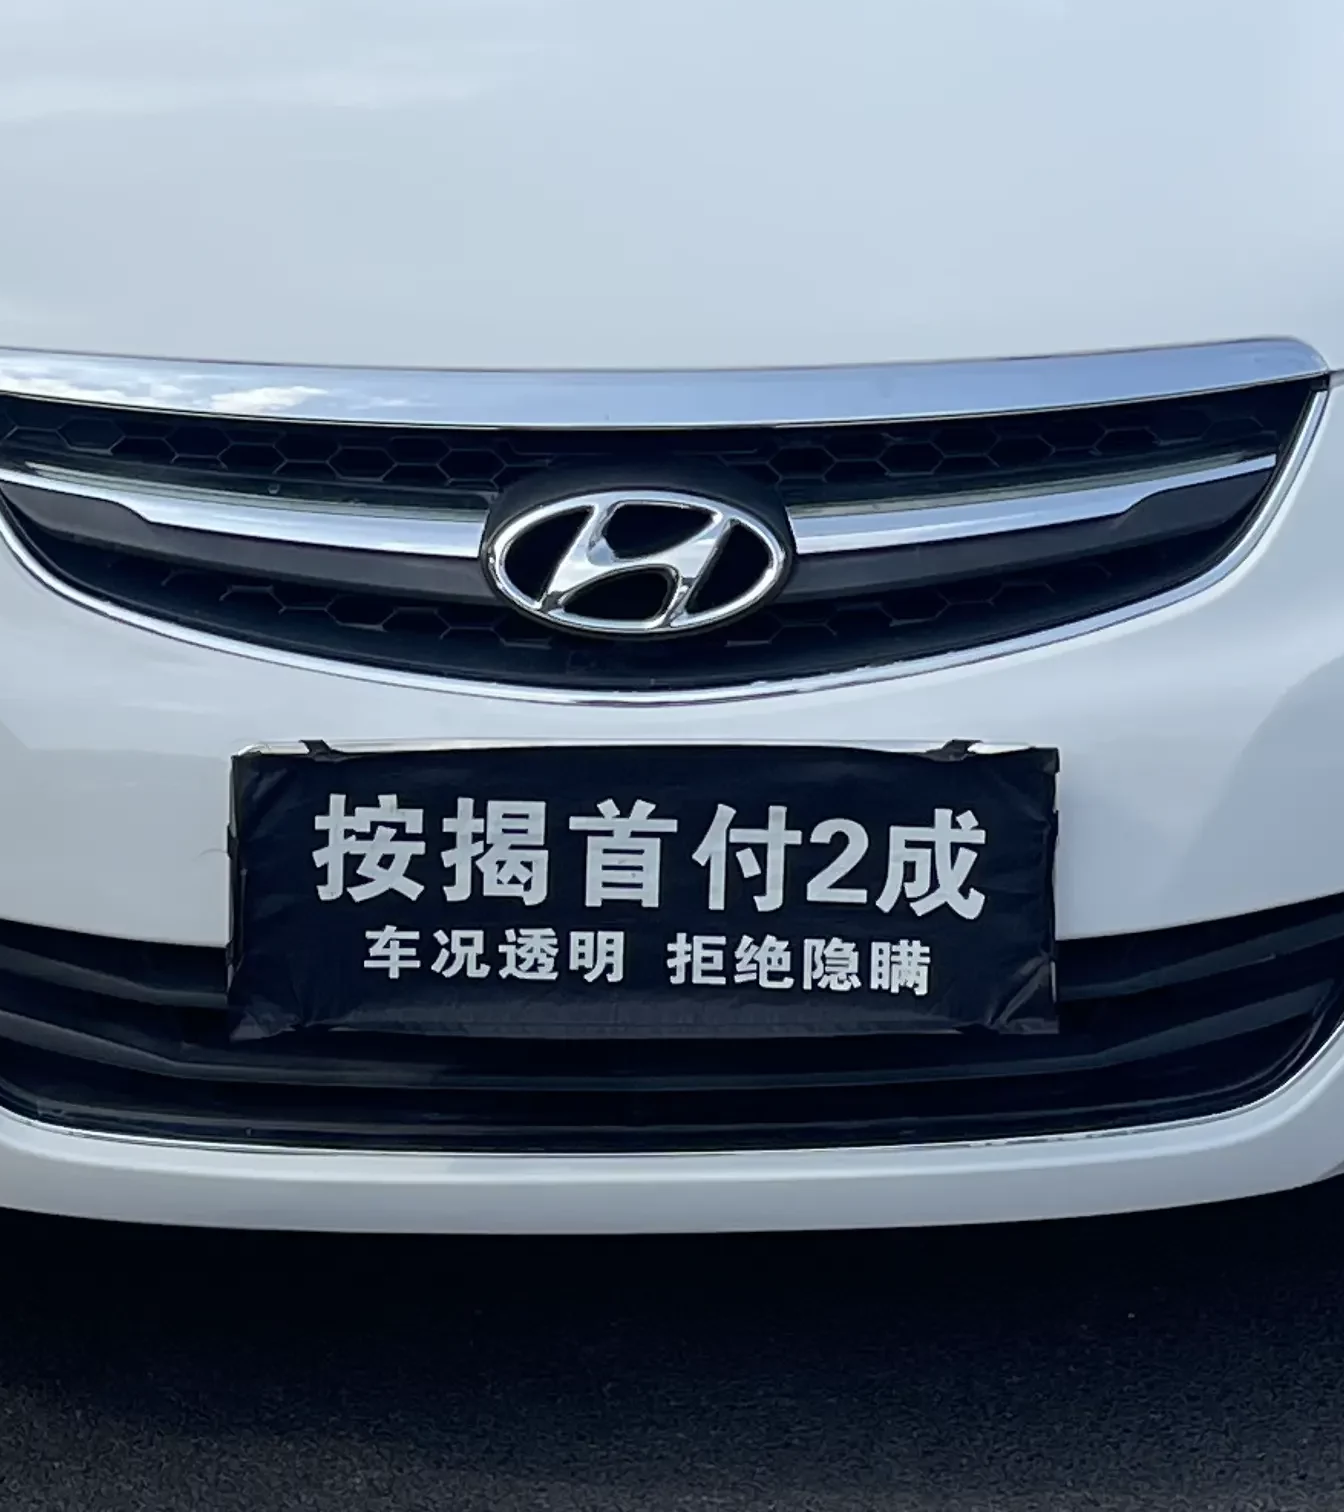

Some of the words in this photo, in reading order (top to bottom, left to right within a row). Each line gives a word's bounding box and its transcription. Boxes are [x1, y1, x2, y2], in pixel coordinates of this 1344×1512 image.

[312, 793, 987, 919] 按揭首付2成
[363, 924, 626, 983] 车况透明
[666, 932, 932, 996] 拒绝隐瞒
